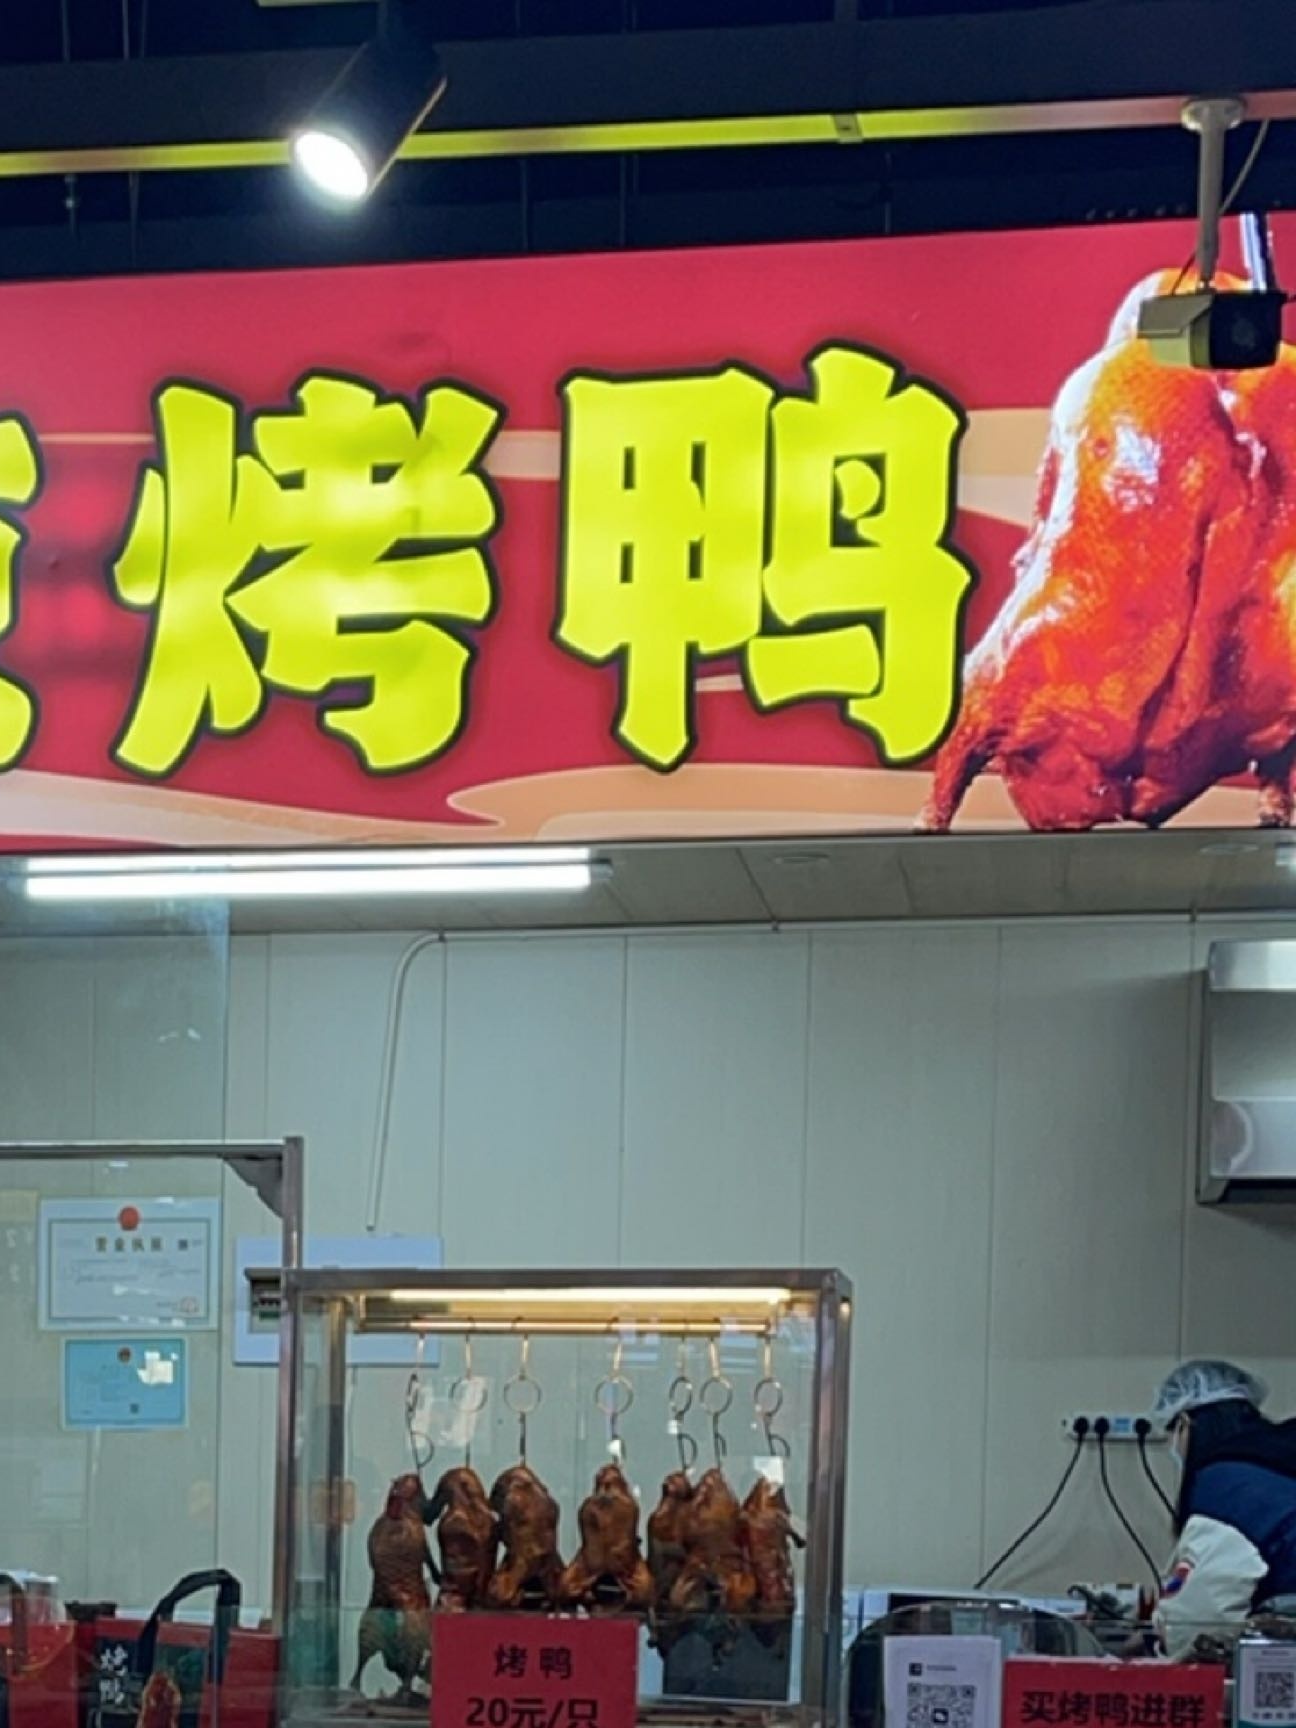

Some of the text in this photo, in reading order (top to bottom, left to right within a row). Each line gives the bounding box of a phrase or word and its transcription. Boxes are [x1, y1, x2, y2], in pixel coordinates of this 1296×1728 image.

[493, 1643, 573, 1680] 烤鸭
[1020, 1690, 1205, 1728] 买烤鸭进群
